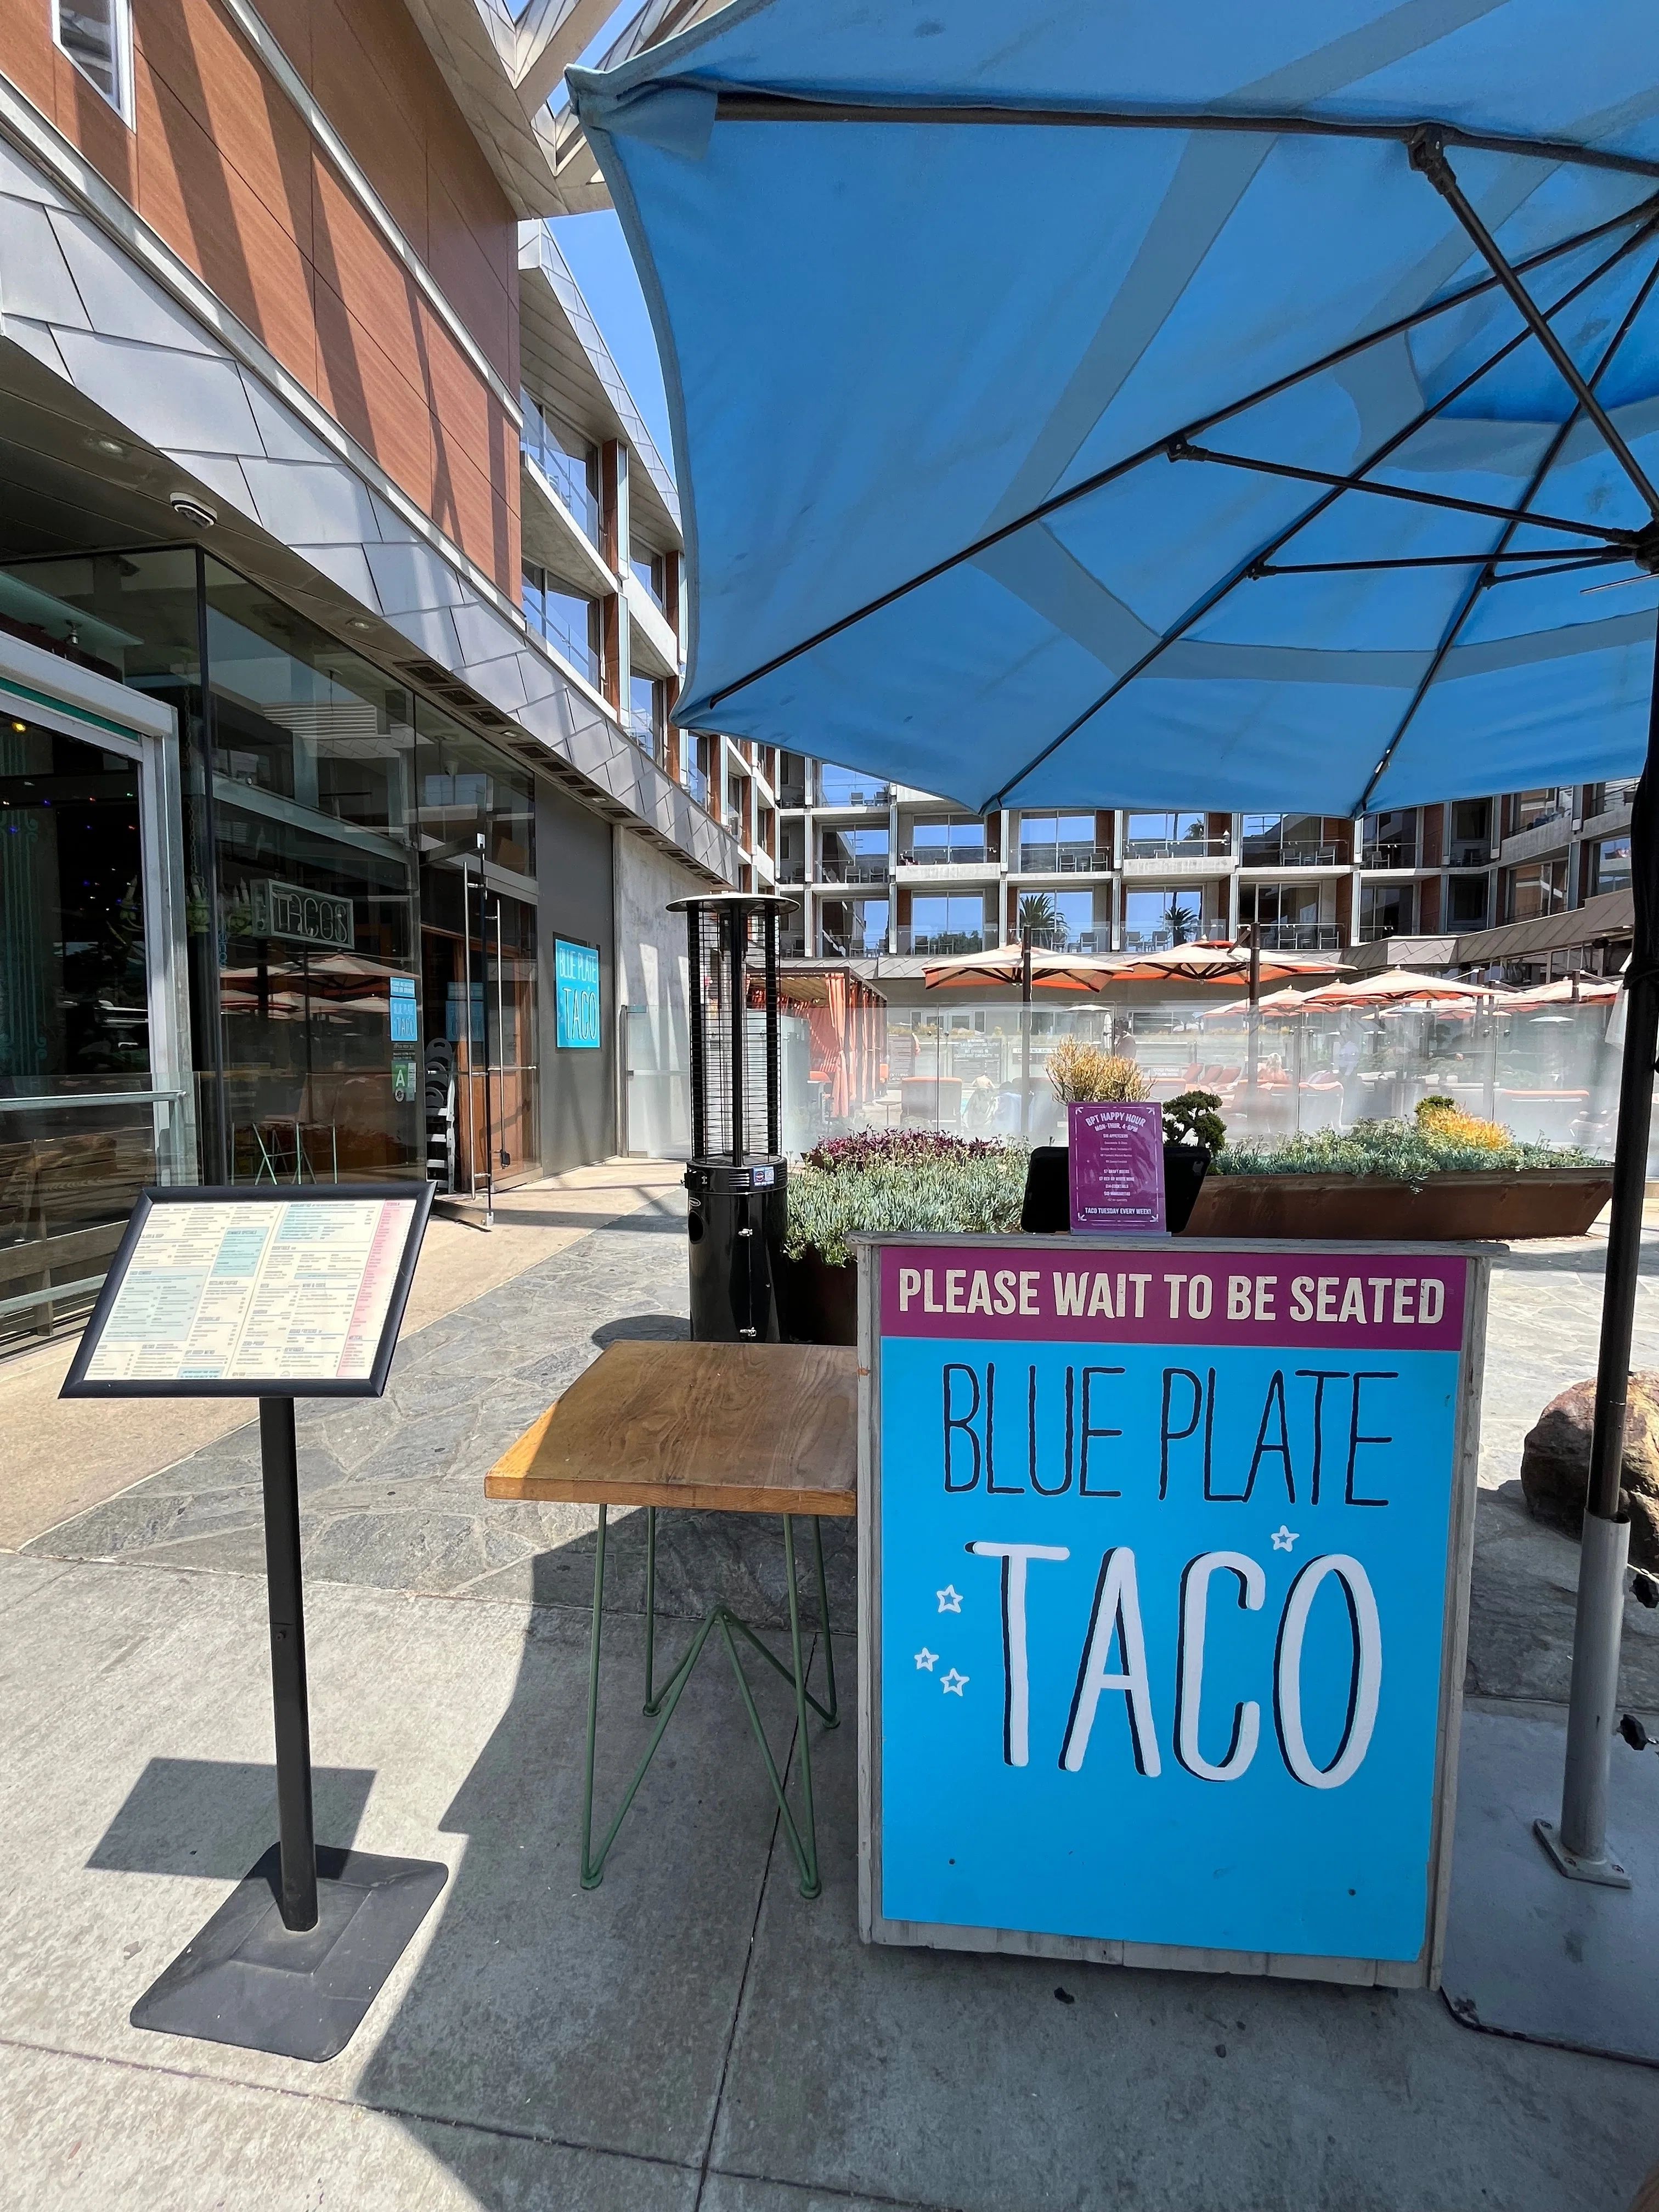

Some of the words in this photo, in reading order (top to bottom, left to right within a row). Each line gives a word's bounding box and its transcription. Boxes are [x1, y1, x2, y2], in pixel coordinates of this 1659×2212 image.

[272, 891, 347, 943] TACOS
[559, 947, 576, 979] BLUE
[578, 952, 596, 983] PLATE
[396, 1017, 415, 1037] TACO
[562, 987, 597, 1040] TACO
[396, 1069, 405, 1087] A
[1085, 1114, 1099, 1126] BPT
[1100, 1112, 1125, 1122] HAPPY
[1125, 1114, 1146, 1127] HOUR
[899, 1268, 1040, 1316] PLEASE
[1052, 1272, 1152, 1319] WAIT
[1164, 1273, 1213, 1319] TO
[1227, 1274, 1278, 1321] BE
[1289, 1276, 1445, 1324] SEATED
[943, 1362, 1126, 1498] BLUE
[1158, 1366, 1399, 1506] PLATE
[964, 1540, 1383, 1790] TACO
